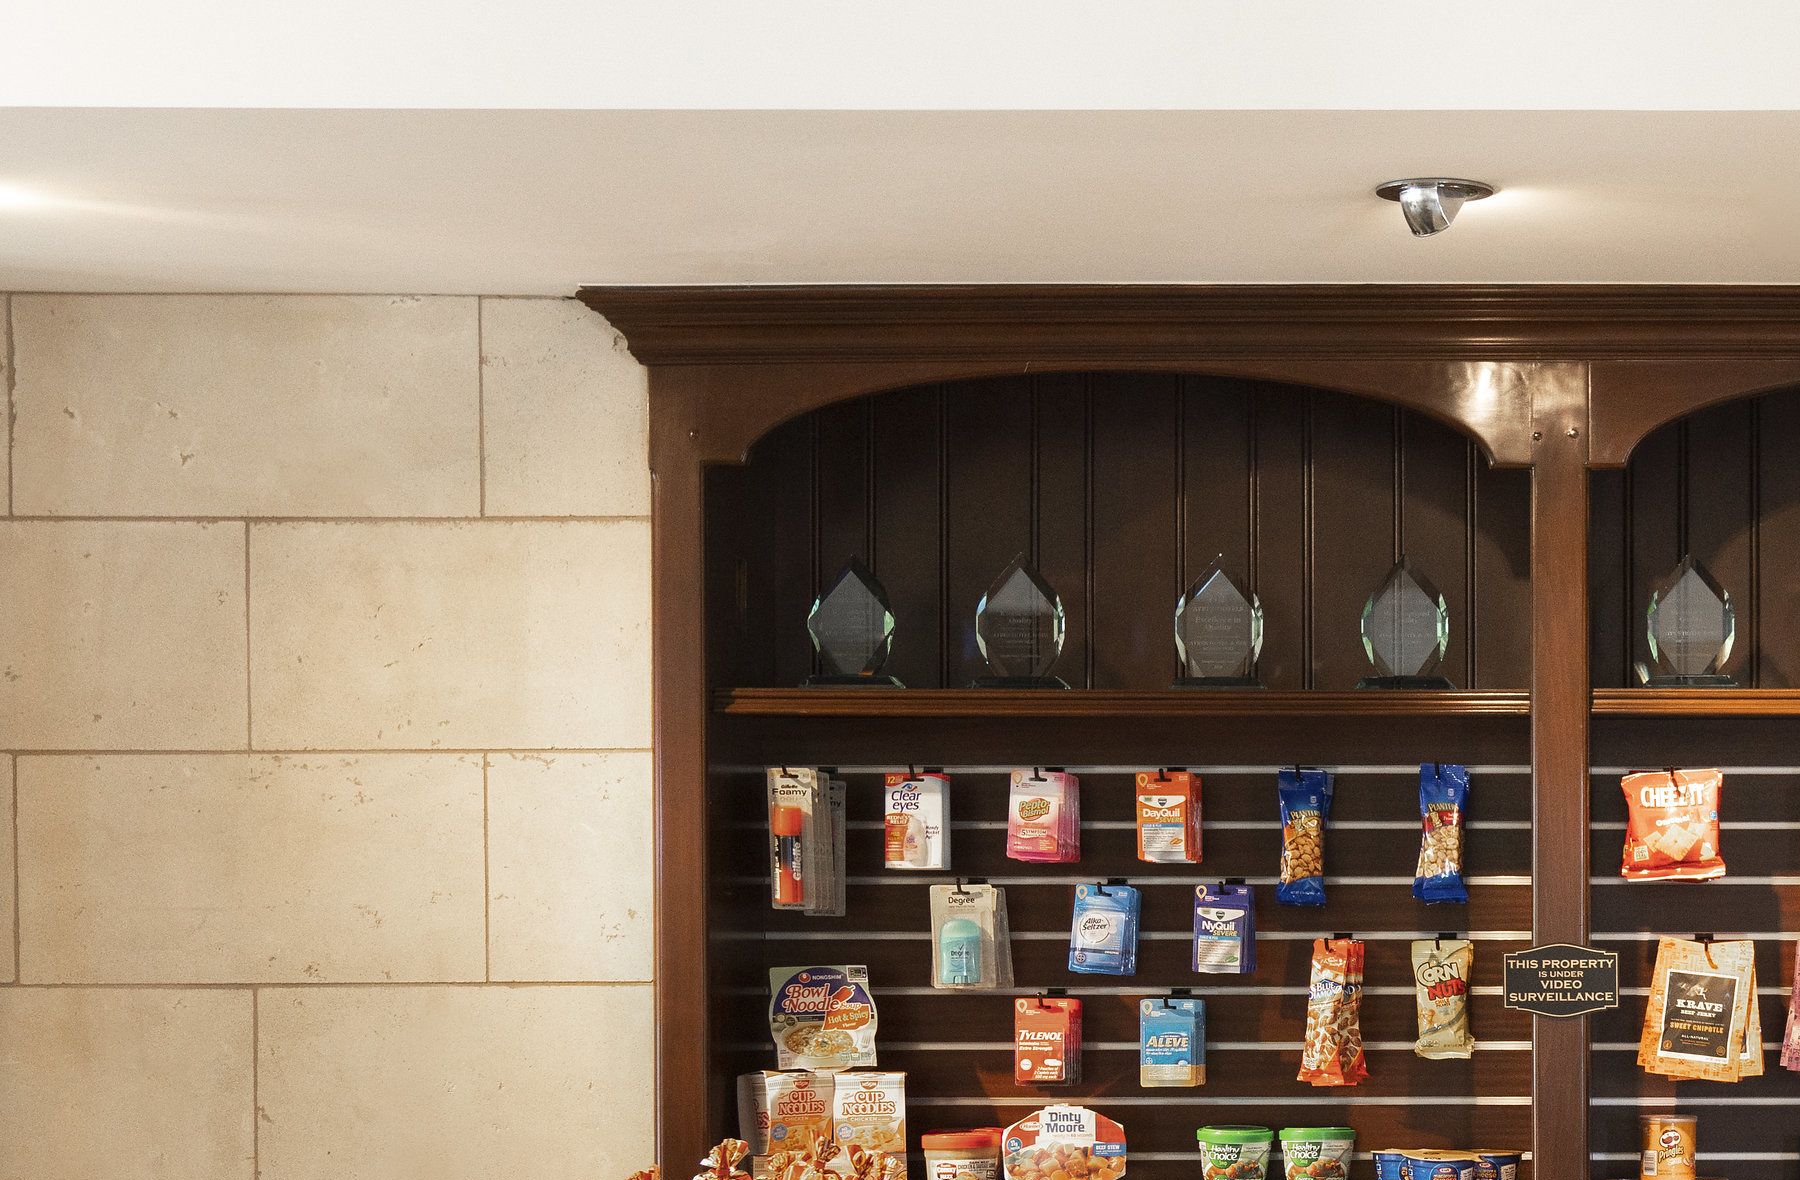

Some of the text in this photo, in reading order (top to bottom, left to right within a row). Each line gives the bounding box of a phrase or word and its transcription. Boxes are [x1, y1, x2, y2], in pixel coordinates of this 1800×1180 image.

[772, 788, 807, 796] Foamy
[891, 790, 922, 801] Clear
[892, 802, 920, 812] eyes
[1142, 808, 1180, 819] DayQuil
[948, 896, 976, 906] Degree
[1082, 922, 1108, 930] Seltzer
[1202, 920, 1235, 932] NyQuil
[1508, 958, 1614, 969] THIS PROPERTY
[1416, 962, 1460, 987] CORN
[1549, 970, 1584, 978] UNDER
[1316, 982, 1335, 992] BLUE
[1426, 979, 1466, 1001] NUTS
[1540, 980, 1583, 990] VIDEO
[786, 983, 830, 1000] Bowl
[1508, 992, 1614, 1002] SURVEILLANCE
[782, 997, 840, 1014] Noodle
[1676, 998, 1724, 1012] KRAVE
[828, 1010, 869, 1024] Hot & Spicy
[1670, 1022, 1724, 1034] SWEET CHIPOTLE
[1018, 1030, 1062, 1040] TYLENOL
[1146, 1036, 1189, 1048] ALEVE
[788, 1090, 816, 1103] CUP
[854, 1090, 886, 1104] CUP
[778, 1101, 826, 1116] NOODLES
[842, 1102, 897, 1116] NOODLES
[1048, 1112, 1082, 1124] Dinty
[1045, 1123, 1085, 1133] Moore
[1212, 1144, 1240, 1154] Healthy
[1292, 1142, 1320, 1153] Healthy
[1208, 1152, 1238, 1160] Choice
[1290, 1150, 1318, 1159] Choice
[1658, 1145, 1684, 1163] Pringles
